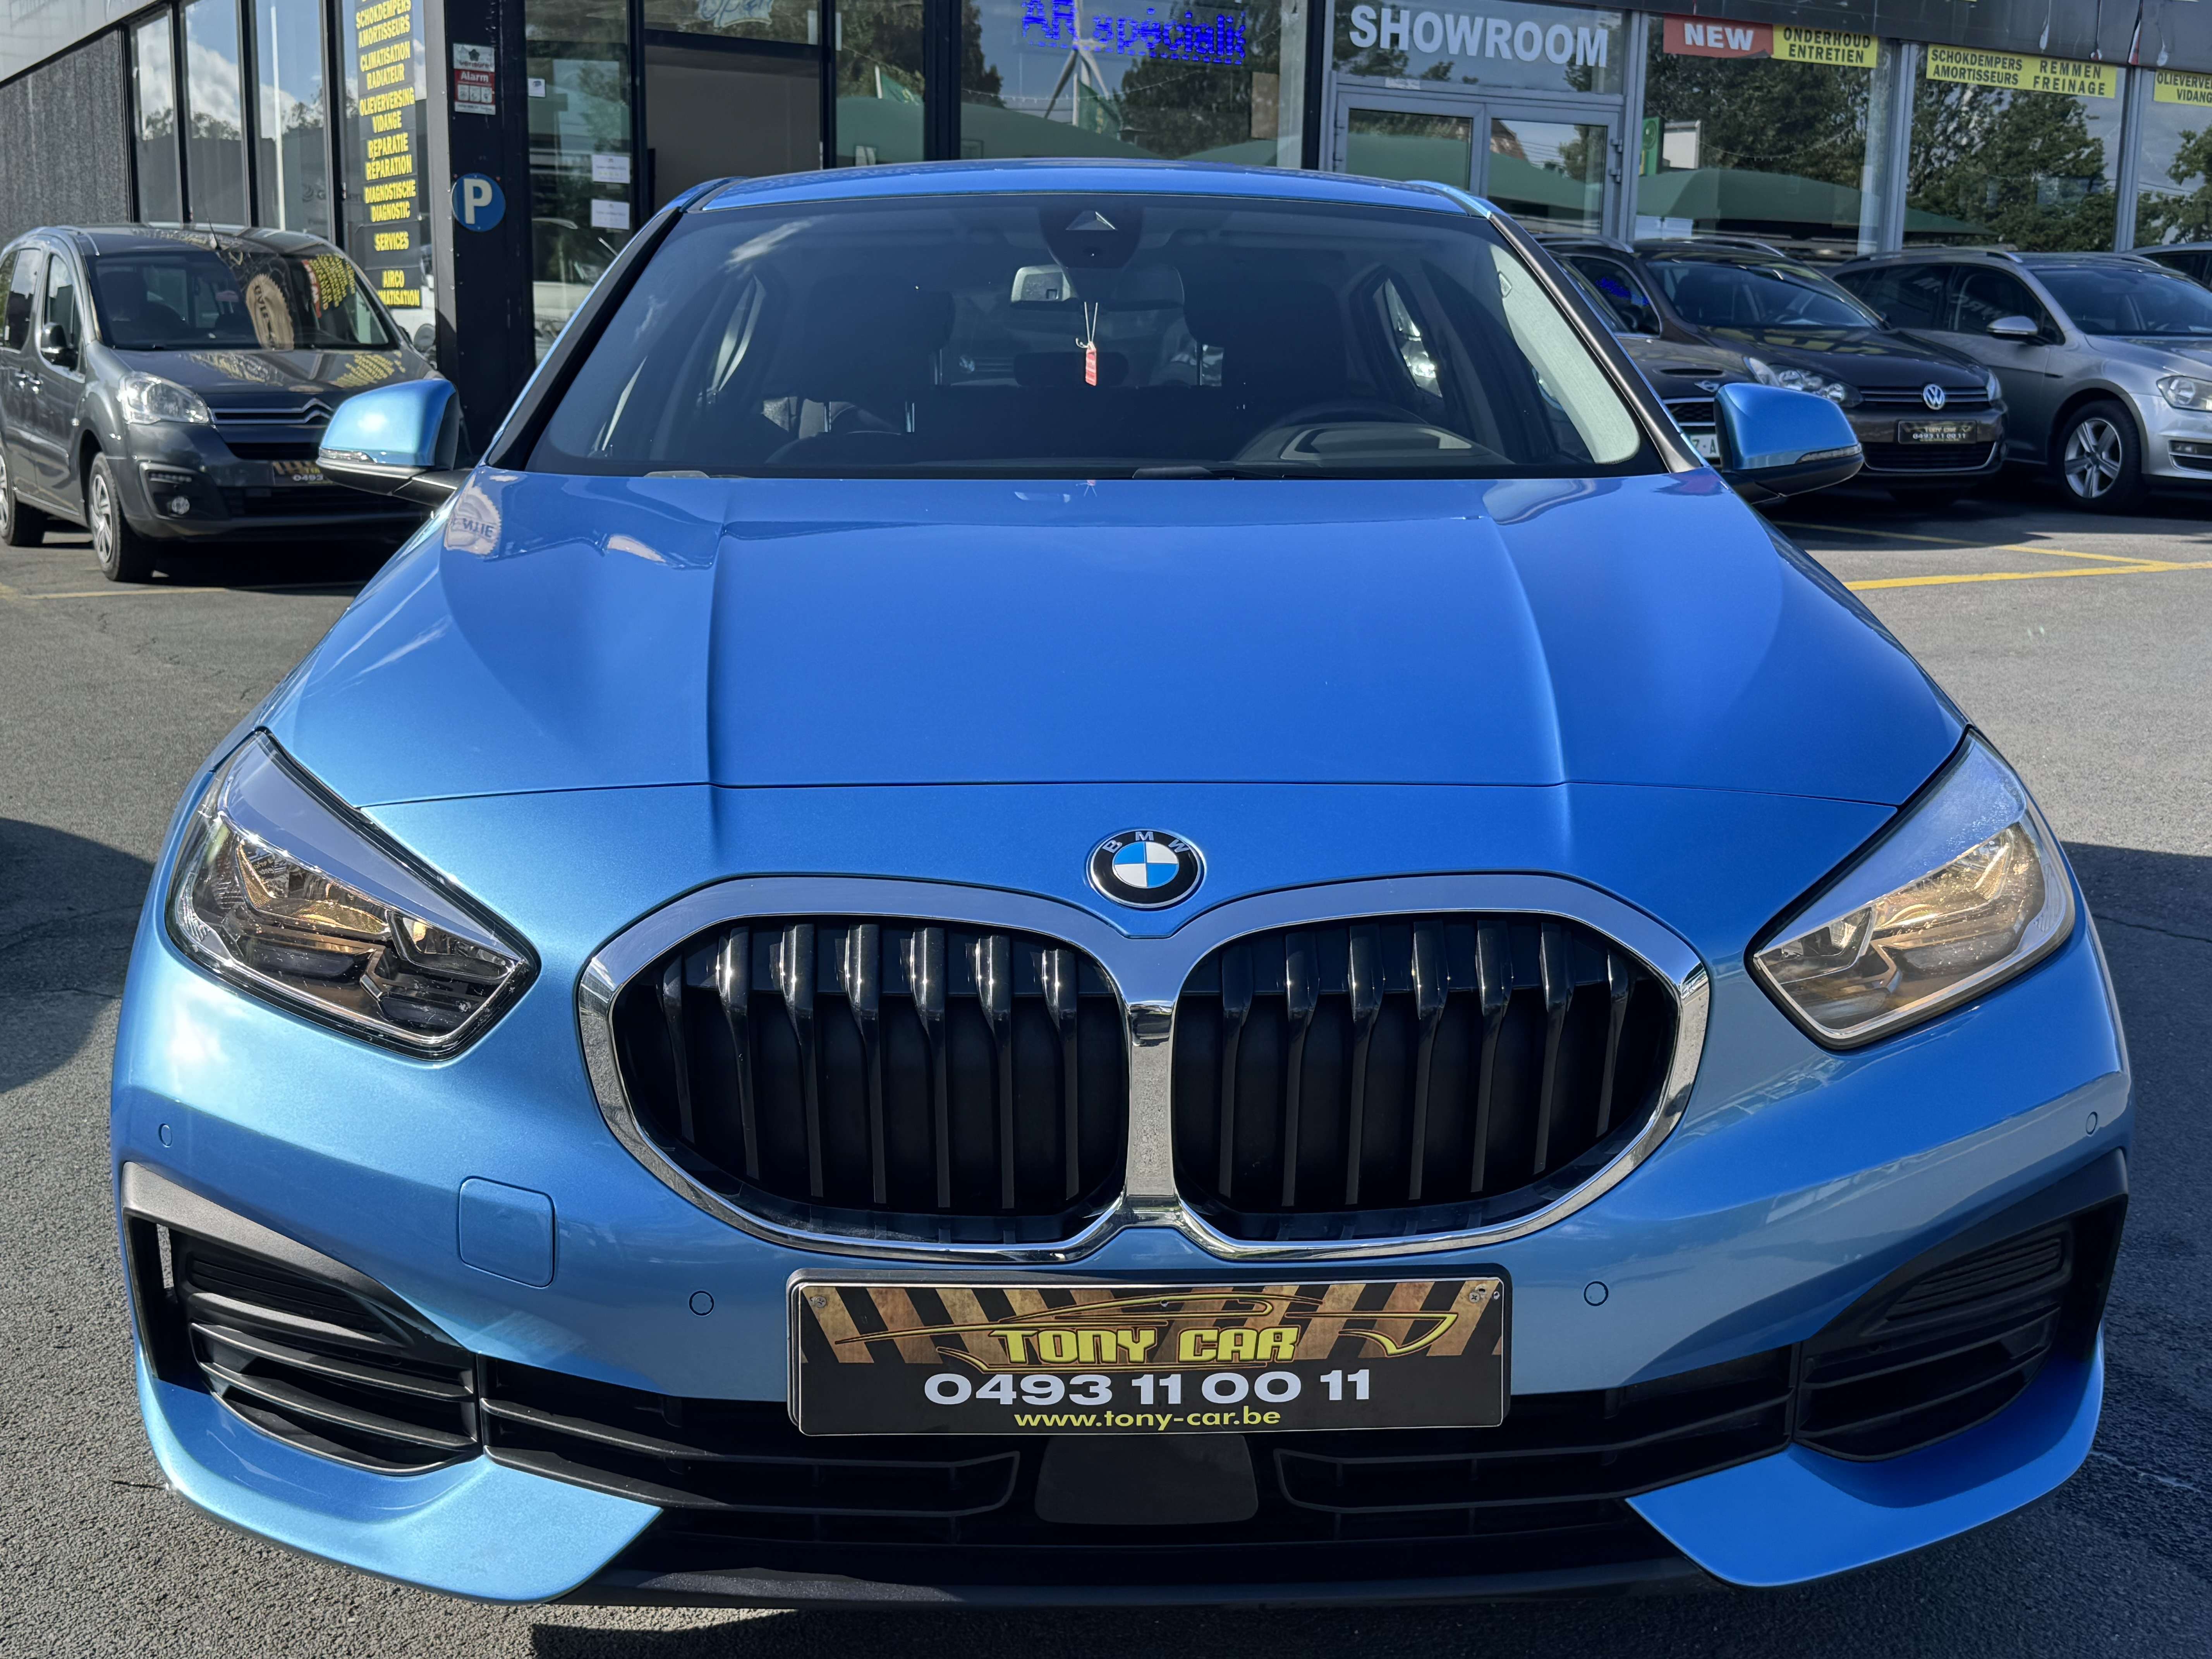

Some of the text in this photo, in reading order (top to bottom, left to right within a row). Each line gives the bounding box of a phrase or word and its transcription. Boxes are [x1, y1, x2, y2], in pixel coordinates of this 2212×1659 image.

[356, 0, 411, 29] SCHOKDEMPERS
[359, 14, 410, 48] AMORTISSEURS
[1349, 5, 1608, 68] SHOWROOM
[1683, 22, 1754, 51] NEW
[1783, 27, 1870, 48] ONDERHOUD
[360, 40, 410, 72] CLIMATISATION
[1788, 44, 1864, 64] ENTRETIEN
[1931, 49, 2023, 71] SCHOKDEMPERS
[367, 63, 405, 90] RADIATEUR
[460, 72, 489, 82] Alarm
[1933, 65, 2019, 86] AMORTISSEURS
[2040, 60, 2102, 79] REMMEN
[2157, 72, 2212, 90] OLIEVERVE
[2033, 76, 2106, 96] FREINAGE
[359, 86, 415, 116] OLIEVERVERSING
[372, 110, 402, 133] VIDANGE
[367, 132, 409, 158] REPARATIE
[365, 154, 412, 180] RÉPARATION
[364, 179, 416, 204] DIAGNOSTISCHE
[464, 179, 493, 224] P
[371, 200, 410, 222] DIAGNOSTIC
[374, 231, 409, 251] SERVICES
[382, 270, 405, 288] AIRCO
[1102, 831, 1189, 854] BMW
[990, 1326, 1301, 1364] TONY CAR
[924, 1369, 1369, 1405] 0493 11 00 11
[1014, 1405, 1281, 1430] www.tony-car.be
